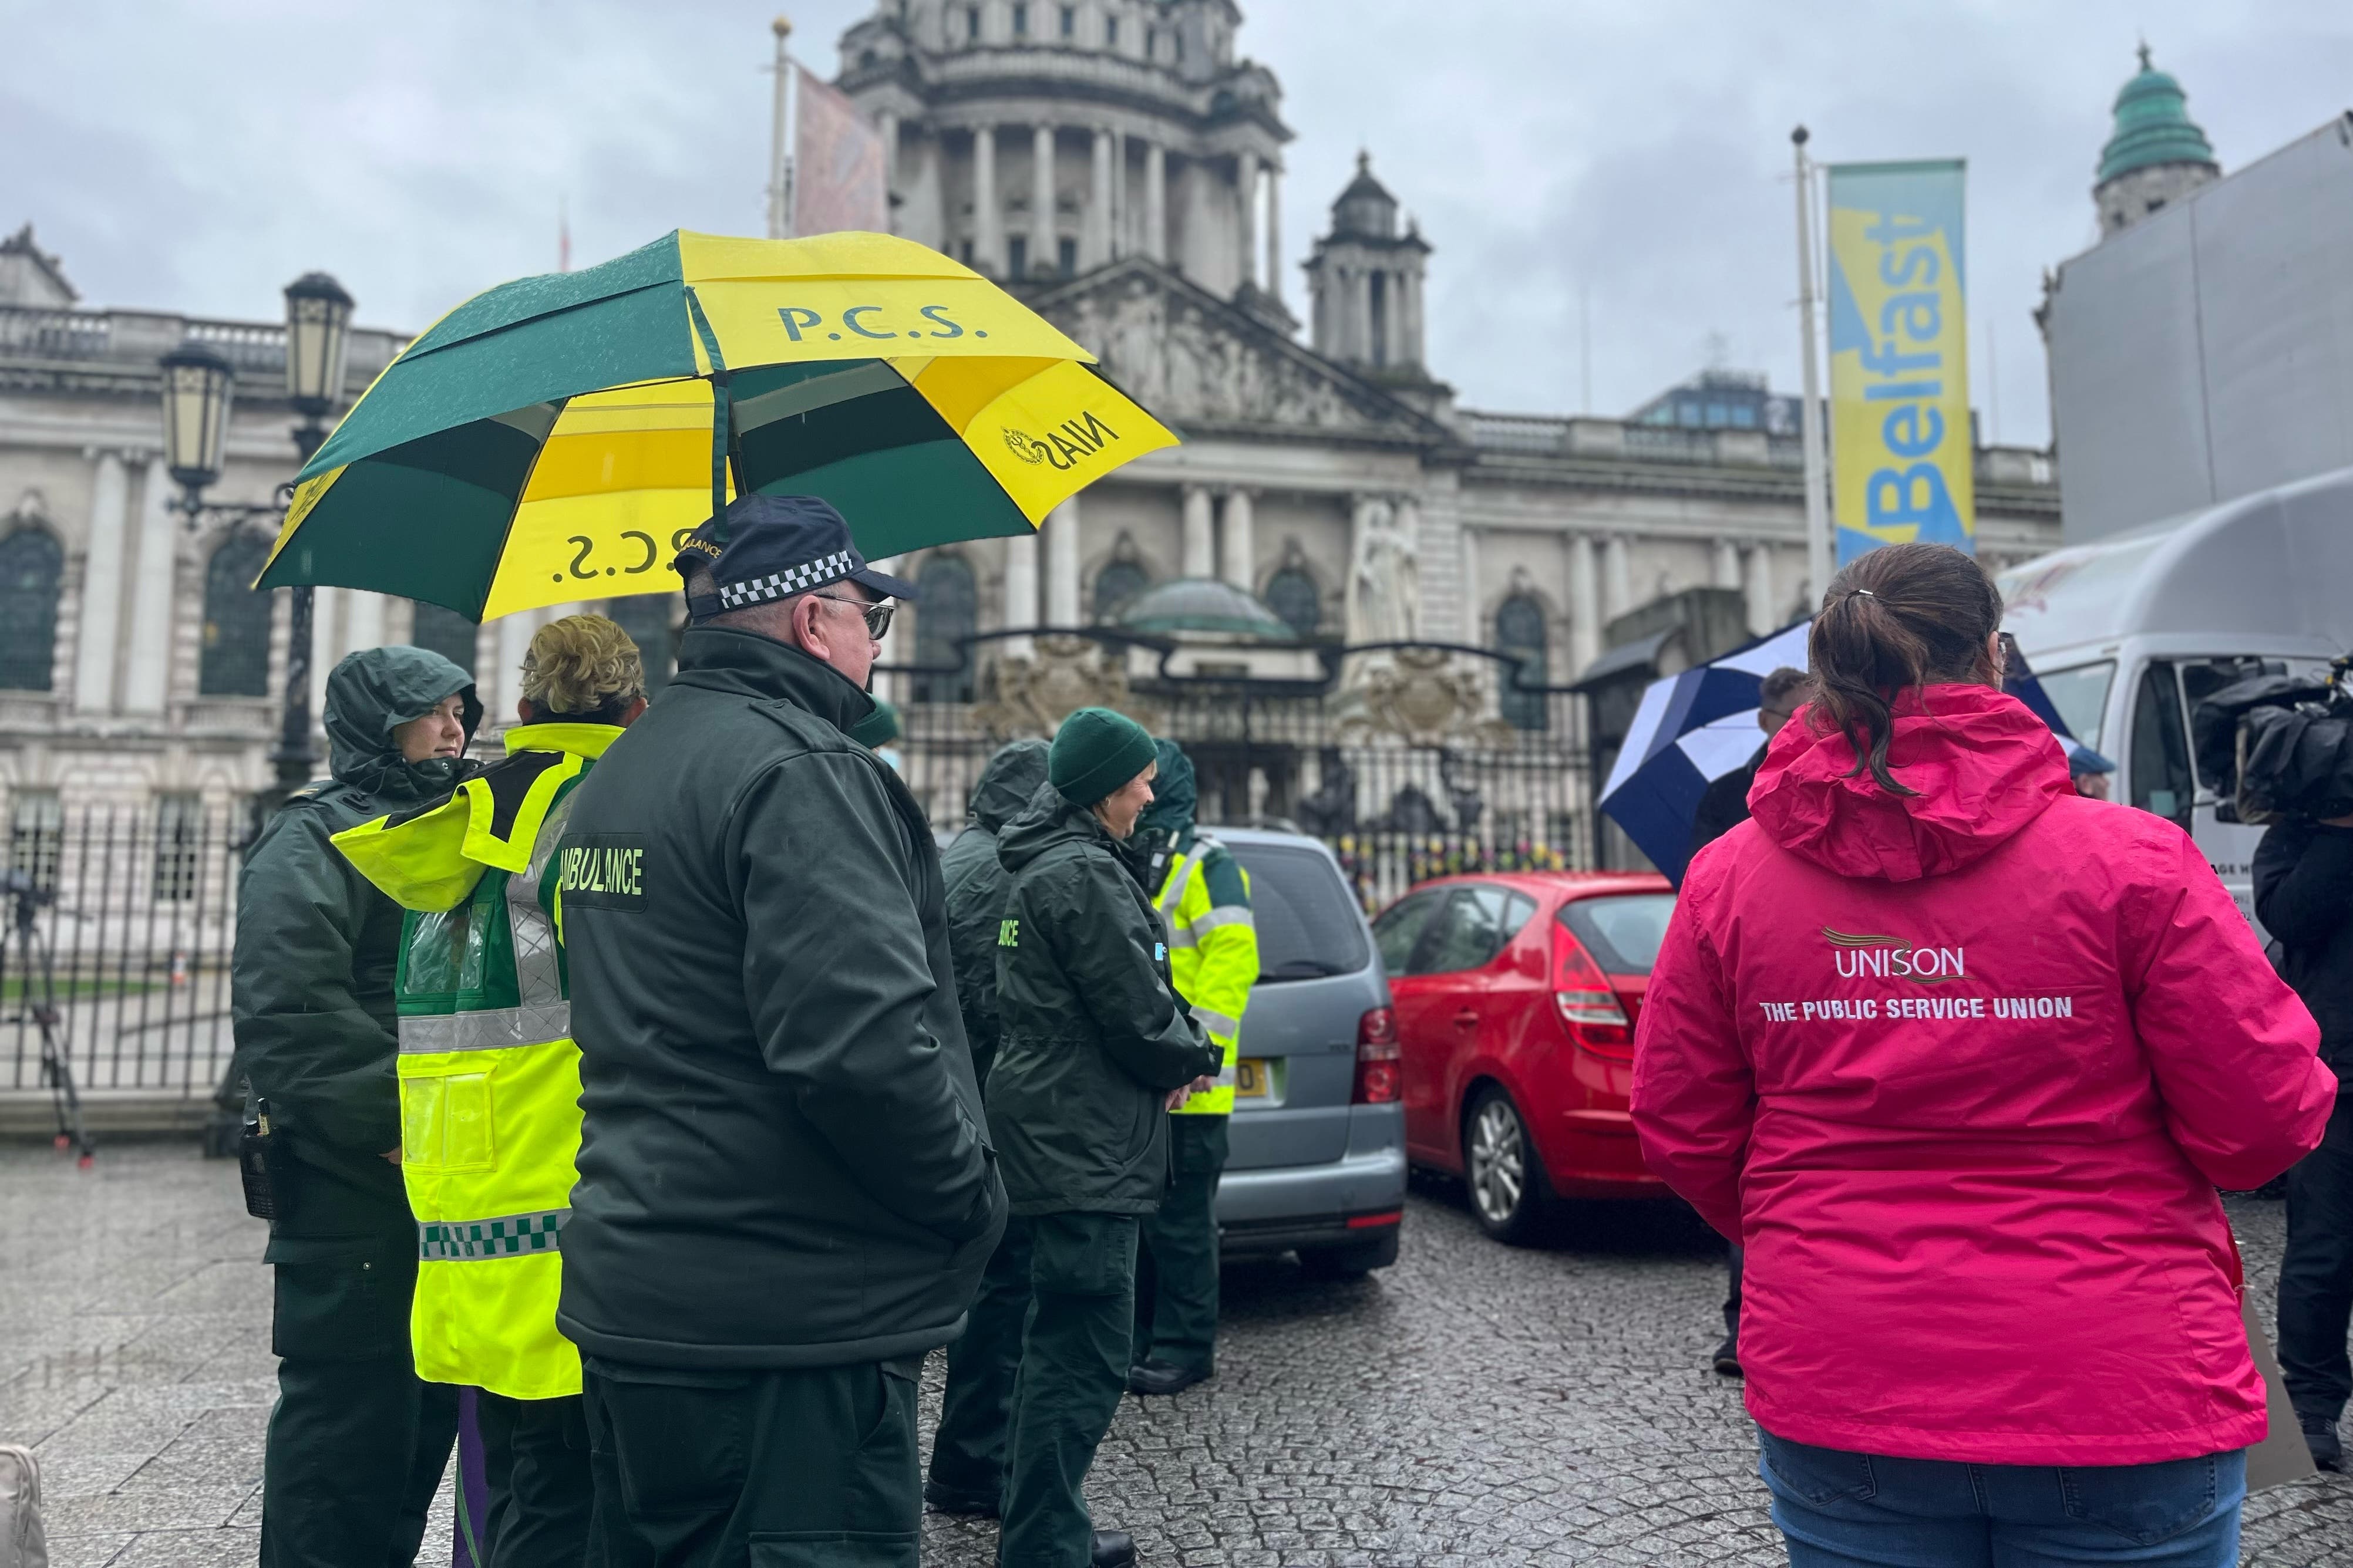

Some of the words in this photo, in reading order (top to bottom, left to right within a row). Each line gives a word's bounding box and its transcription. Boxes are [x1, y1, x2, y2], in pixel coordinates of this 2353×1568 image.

[777, 305, 988, 342] P.C.S.
[1860, 210, 1945, 528] Belfast
[1834, 947, 1964, 979] UNISON
[1759, 1002, 1798, 1022] THE
[1802, 999, 1878, 1021] PUBLIC
[1886, 998, 1985, 1020] SERVICE
[1993, 996, 2073, 1019] UNION
